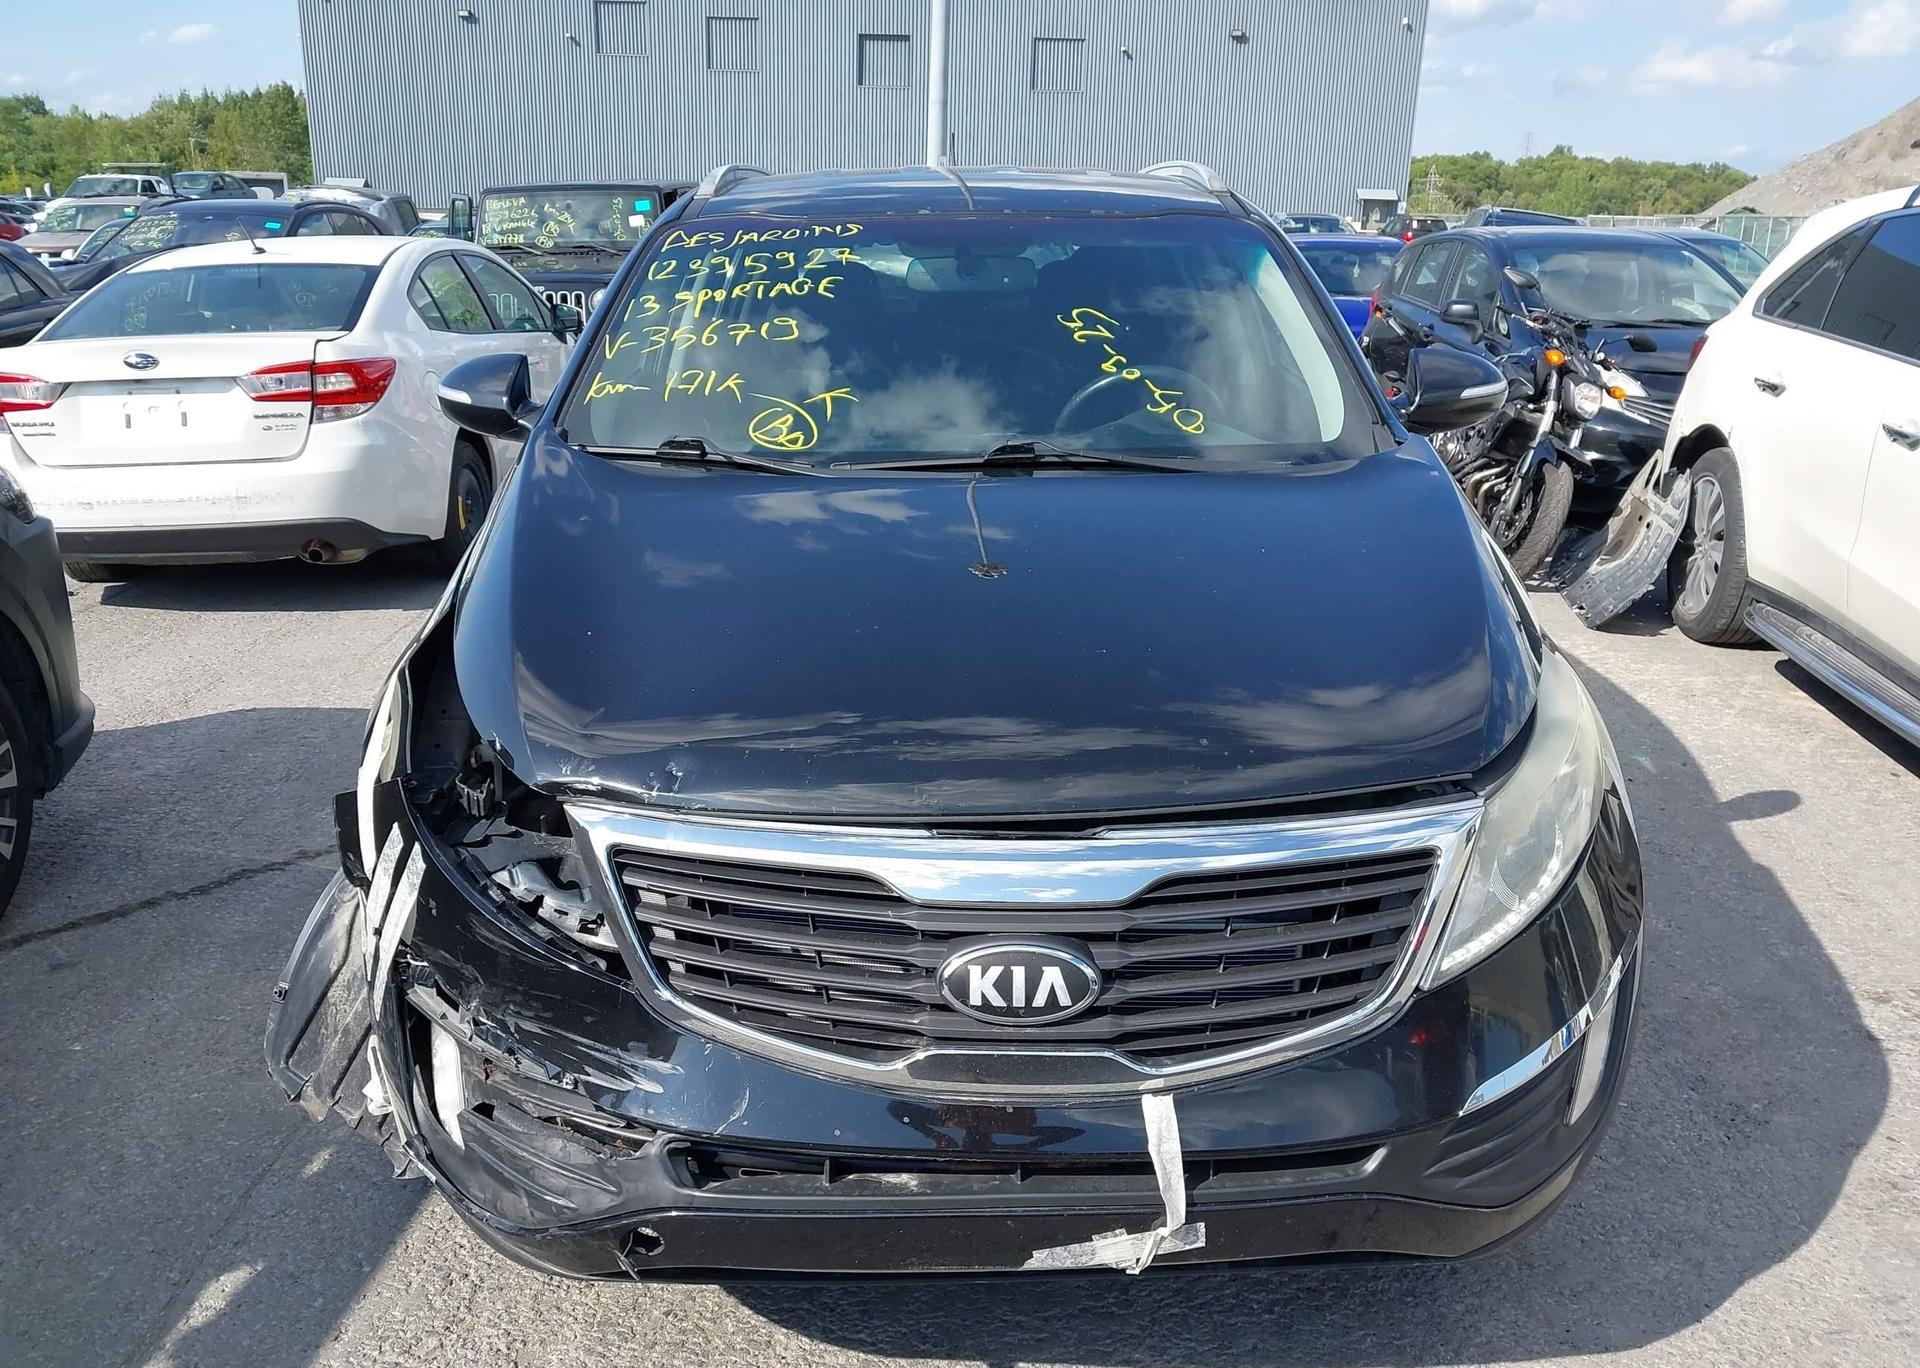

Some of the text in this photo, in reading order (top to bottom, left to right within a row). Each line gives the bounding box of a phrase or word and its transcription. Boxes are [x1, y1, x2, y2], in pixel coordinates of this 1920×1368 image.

[623, 276, 845, 321] 13 SPORTAGE
[967, 965, 1073, 1008] KIA
